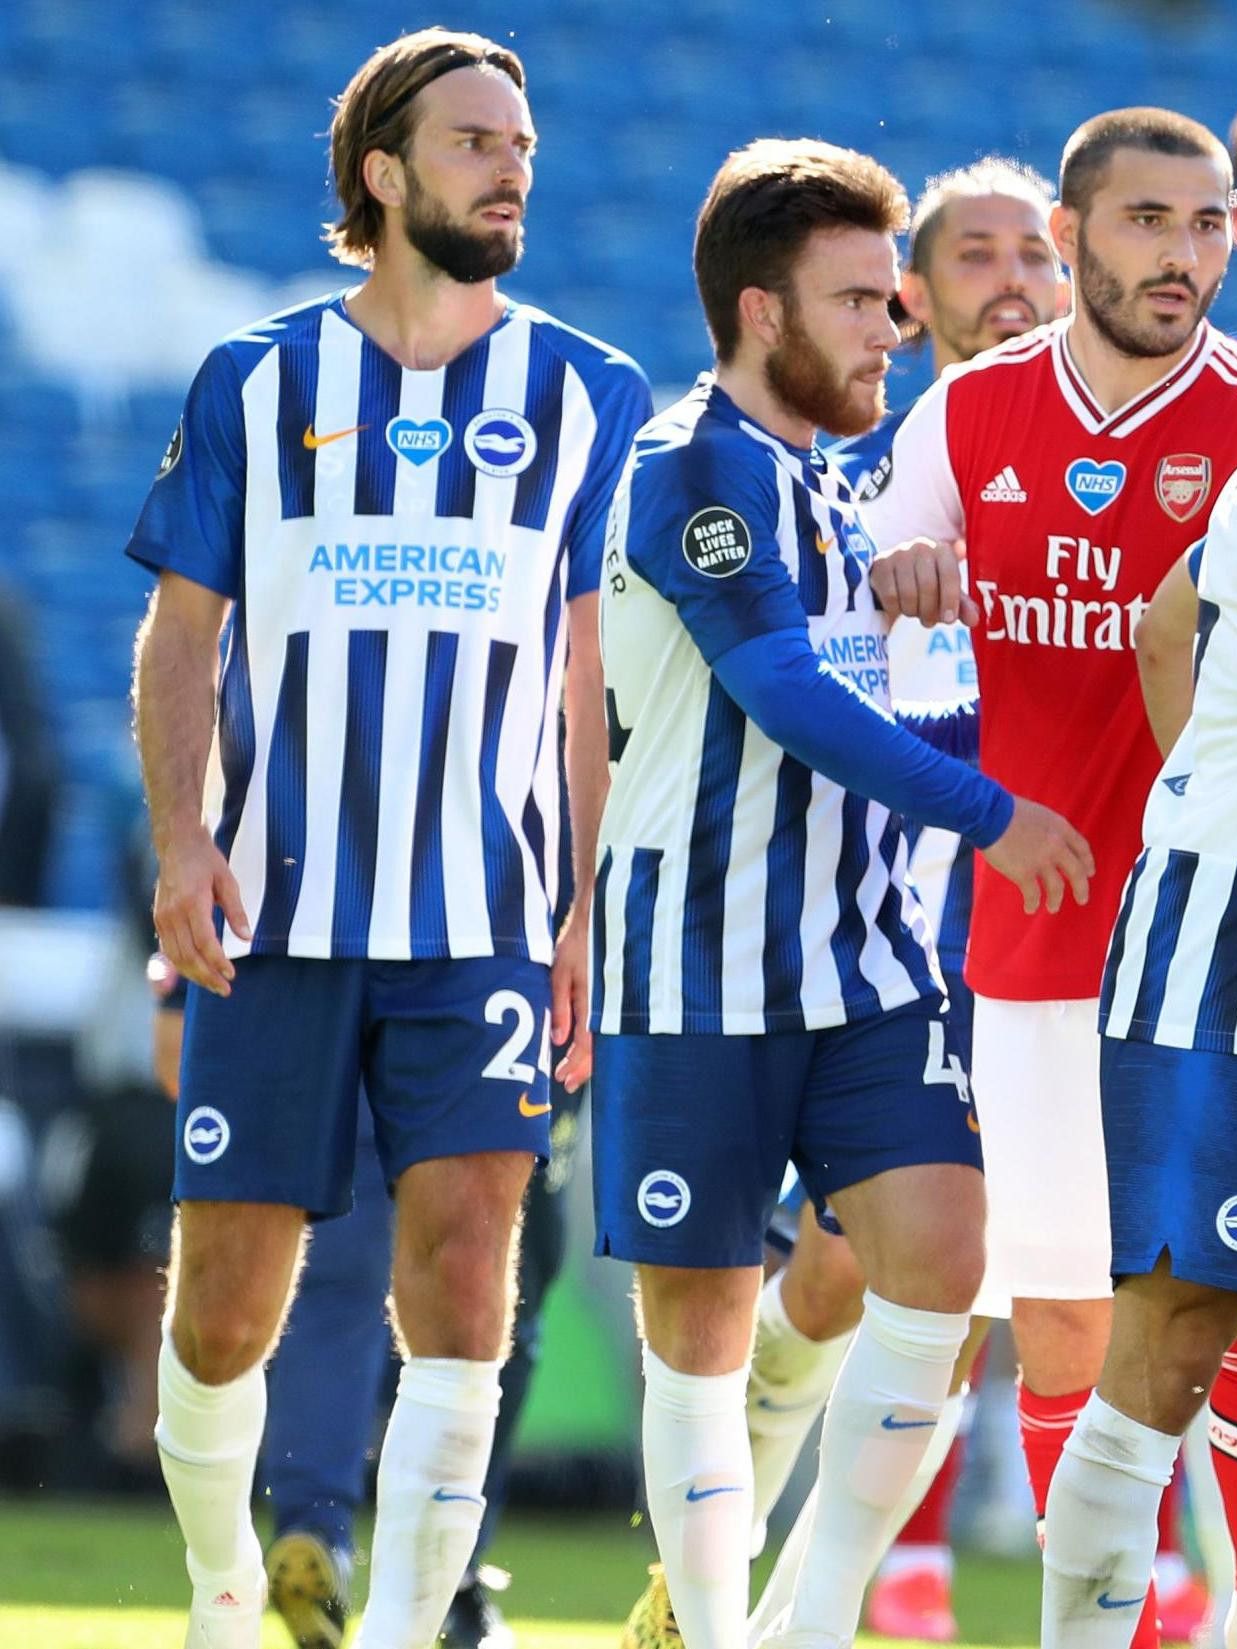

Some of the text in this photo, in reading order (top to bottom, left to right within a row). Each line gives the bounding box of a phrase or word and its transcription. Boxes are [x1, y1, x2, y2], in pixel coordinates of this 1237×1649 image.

[400, 431, 437, 446] NHS
[1078, 475, 1115, 491] NHS
[697, 546, 746, 569] MATTER
[699, 533, 736, 554] LIVES
[309, 543, 507, 580] AMERICAN
[1046, 535, 1122, 591] Fly
[333, 578, 501, 613] EXPRESS
[976, 580, 1151, 651] Emirat
